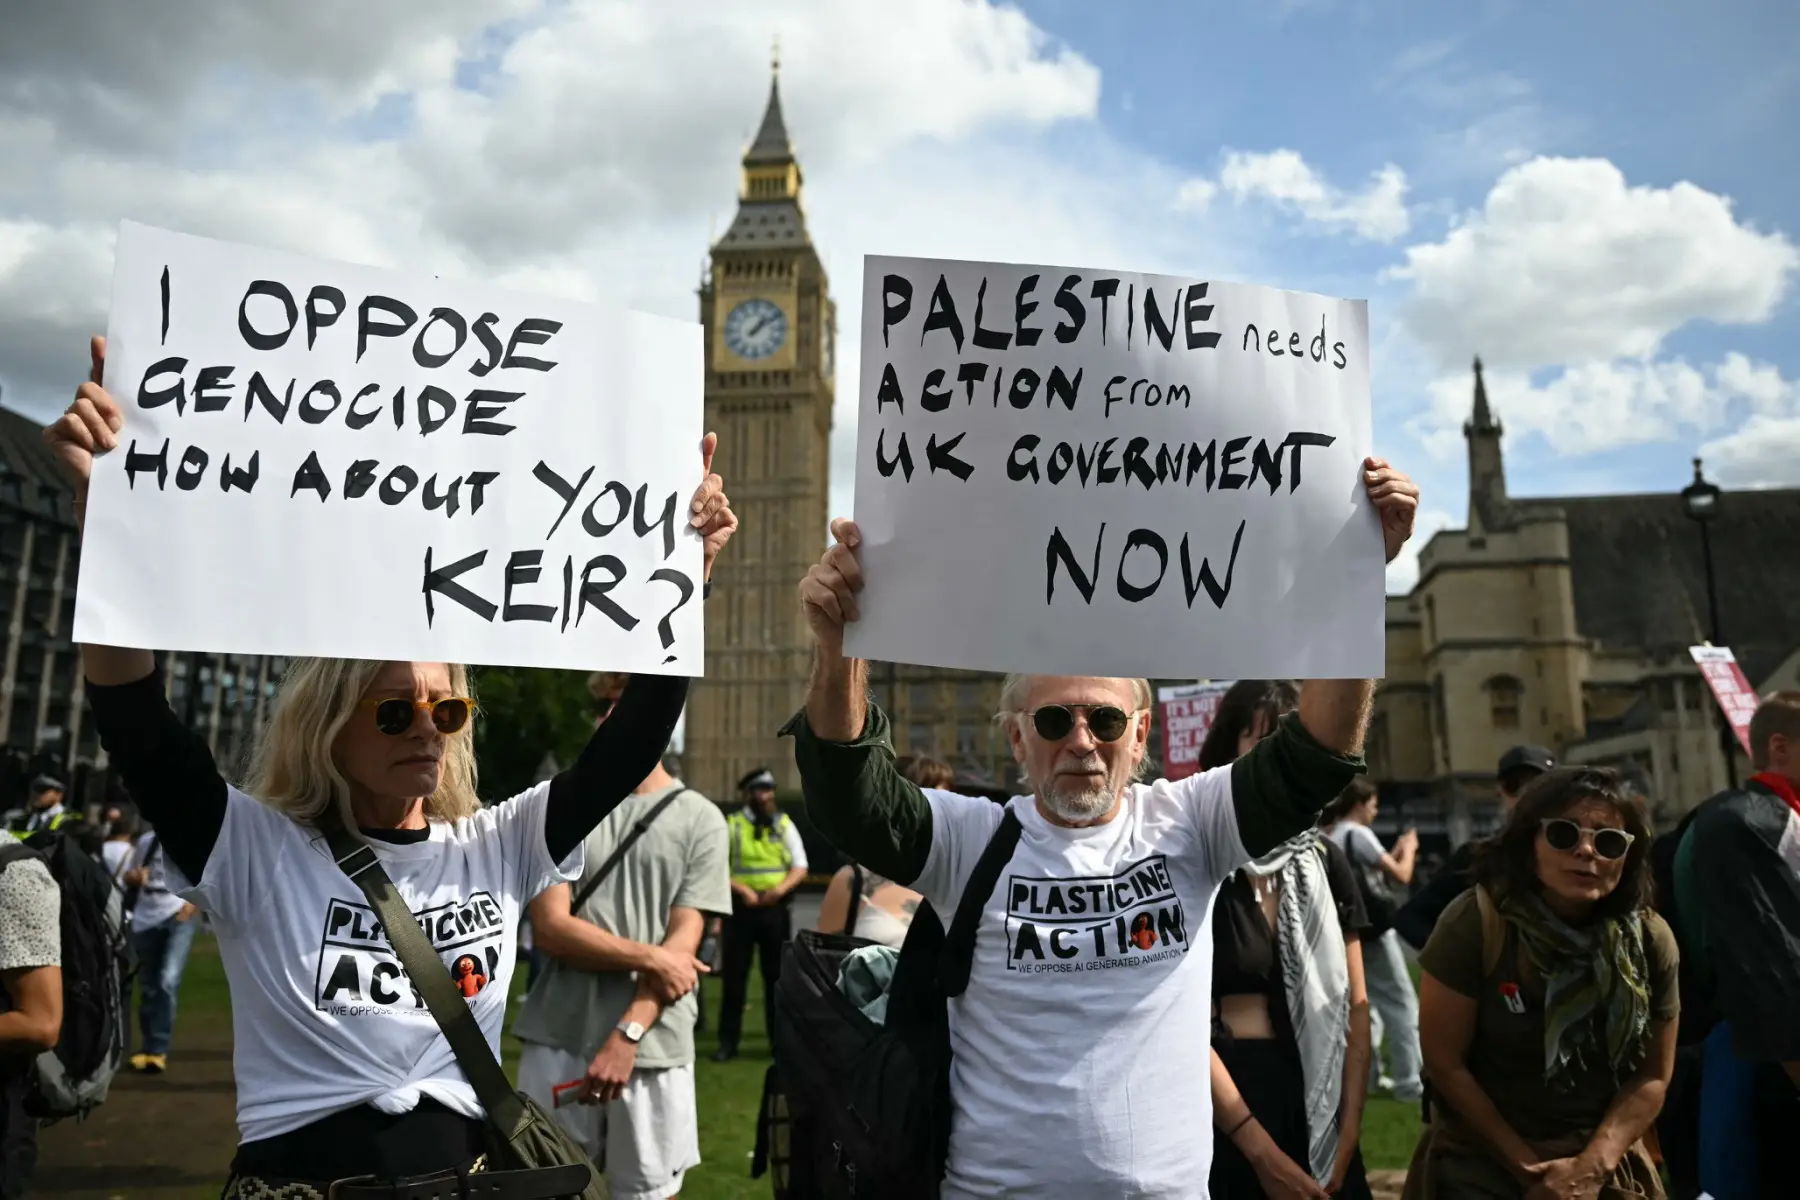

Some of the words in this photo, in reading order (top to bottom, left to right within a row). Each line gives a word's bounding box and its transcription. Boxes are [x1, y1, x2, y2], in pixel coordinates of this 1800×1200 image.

[160, 264, 171, 346] I
[238, 279, 563, 377] OPPOSE
[882, 273, 1222, 355] PALESTINE
[1243, 312, 1347, 370] needs
[137, 356, 526, 437] GENOCIDE
[877, 362, 1083, 416] ACTION
[1103, 375, 1191, 419] from
[875, 427, 976, 484] UK
[1006, 431, 1337, 497] GOVERNMENT
[123, 437, 260, 494] HOW
[290, 450, 501, 519] ABOUT
[532, 460, 678, 561] YOU
[1046, 519, 1246, 610] NOW
[421, 546, 694, 665] KEIR?
[1011, 862, 1170, 914] PLASTICINE
[329, 900, 503, 945] PLICINE
[1013, 904, 1184, 960] ACTION
[321, 943, 503, 1008] ACON
[1018, 963, 1032, 974] WE
[1034, 962, 1073, 974] OPPOSE
[1074, 962, 1084, 971] AI
[1086, 957, 1140, 971] GENERATED
[1141, 949, 1181, 964] ANIMATION
[330, 1005, 347, 1016] WE
